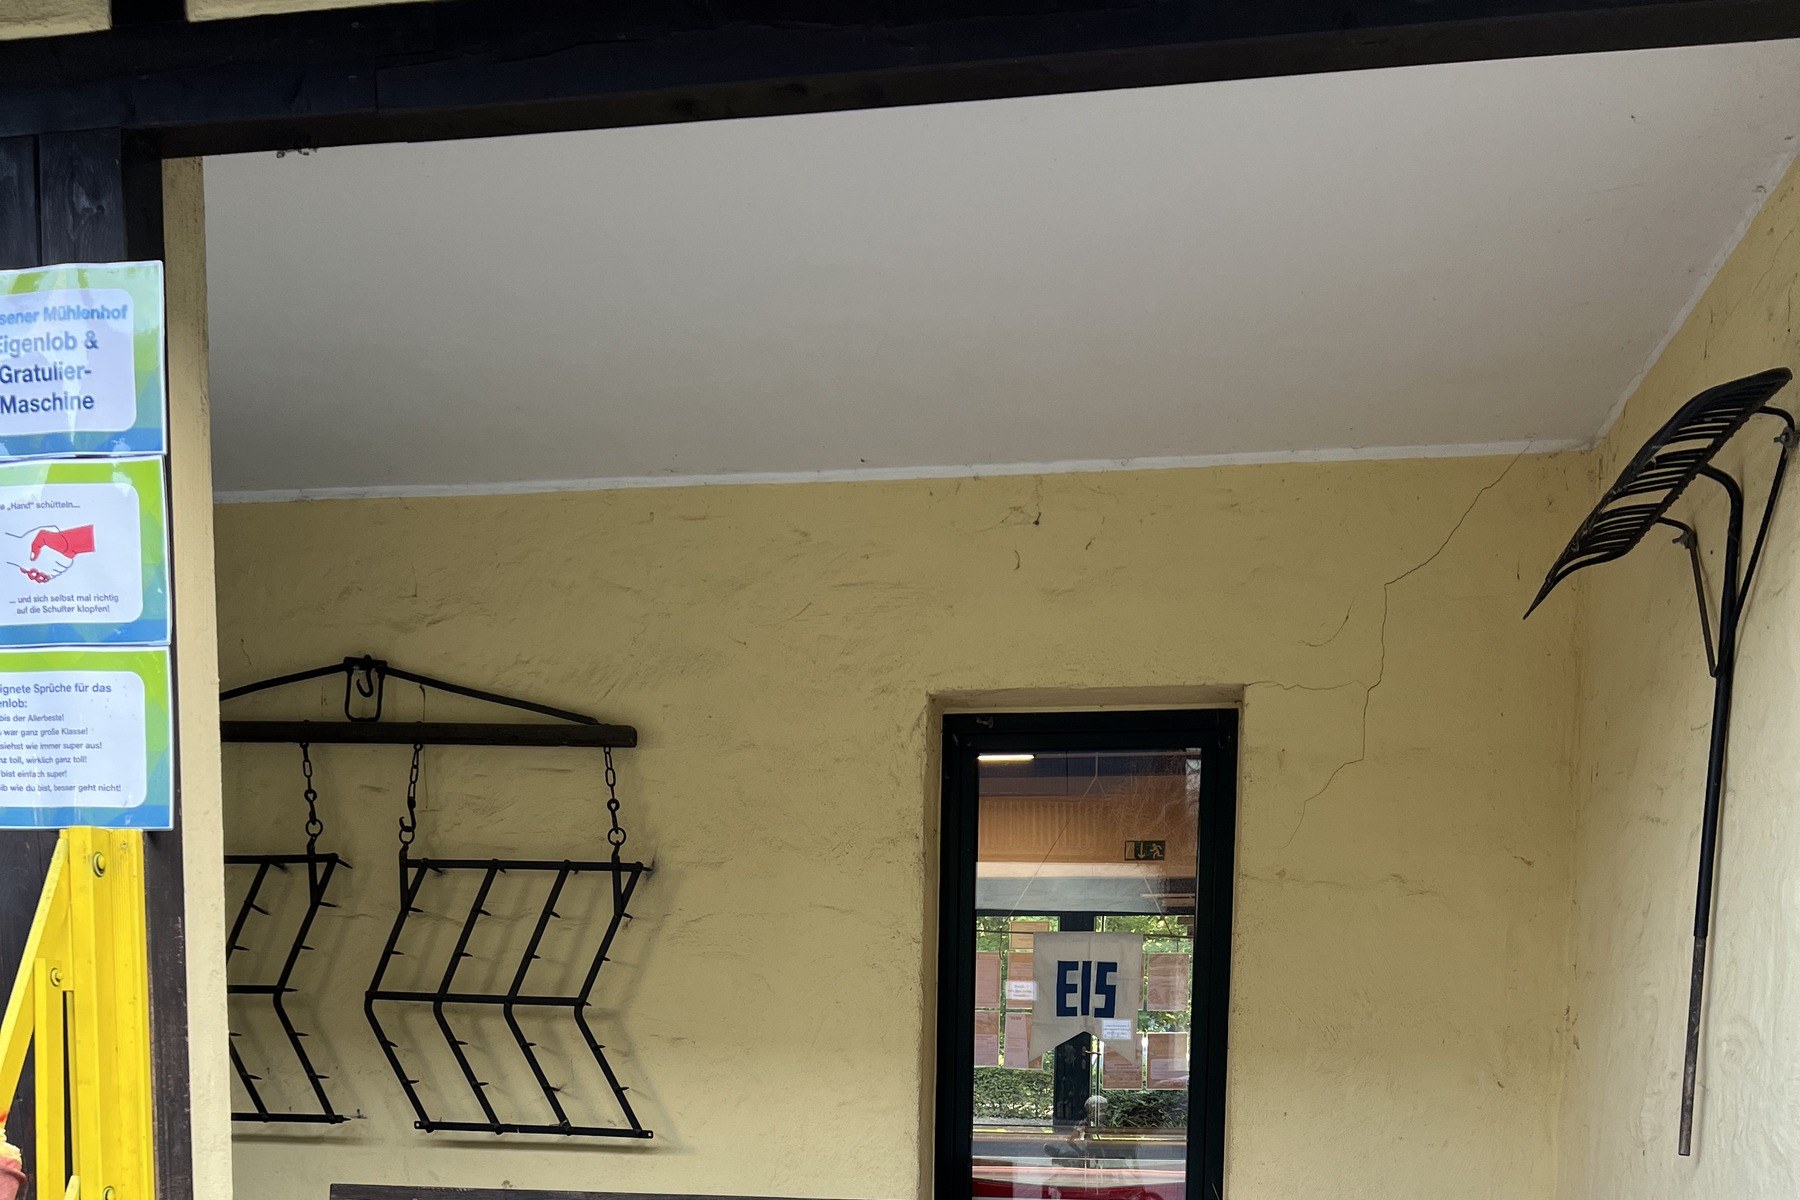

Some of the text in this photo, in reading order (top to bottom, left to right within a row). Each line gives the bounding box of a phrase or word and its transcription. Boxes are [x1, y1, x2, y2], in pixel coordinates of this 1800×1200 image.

[43, 304, 128, 322] Mühlenhof
[84, 330, 99, 350] &
[0, 361, 92, 384] Gratulier-
[0, 391, 95, 414] Maschine
[17, 595, 31, 603] und
[33, 594, 48, 603] sich
[50, 594, 74, 602] selbst
[76, 594, 91, 602] mal
[93, 593, 119, 603] richtig
[16, 604, 110, 614] auf die Schulter klopfen!
[33, 683, 72, 695] Sprüche
[75, 682, 89, 693] für
[92, 683, 112, 693] das
[13, 714, 26, 722] der
[28, 713, 65, 722] Allerbeste!
[20, 730, 38, 738] ganz
[40, 728, 60, 738] große
[61, 727, 89, 736] Klasse!
[0, 742, 23, 750] siehst
[25, 742, 38, 750] wie
[63, 742, 84, 751] super
[85, 741, 102, 749] aus!
[9, 756, 24, 765] toll,
[26, 756, 54, 764] wirklich
[55, 757, 71, 765] ganz
[1, 769, 68, 779] bist einfach super!
[10, 784, 24, 792] wie
[26, 784, 36, 792] du
[38, 784, 52, 792] bist,
[53, 784, 76, 792] besser
[78, 784, 97, 793] geht
[98, 784, 122, 792] nicht!
[1056, 960, 1118, 1019] EIS
